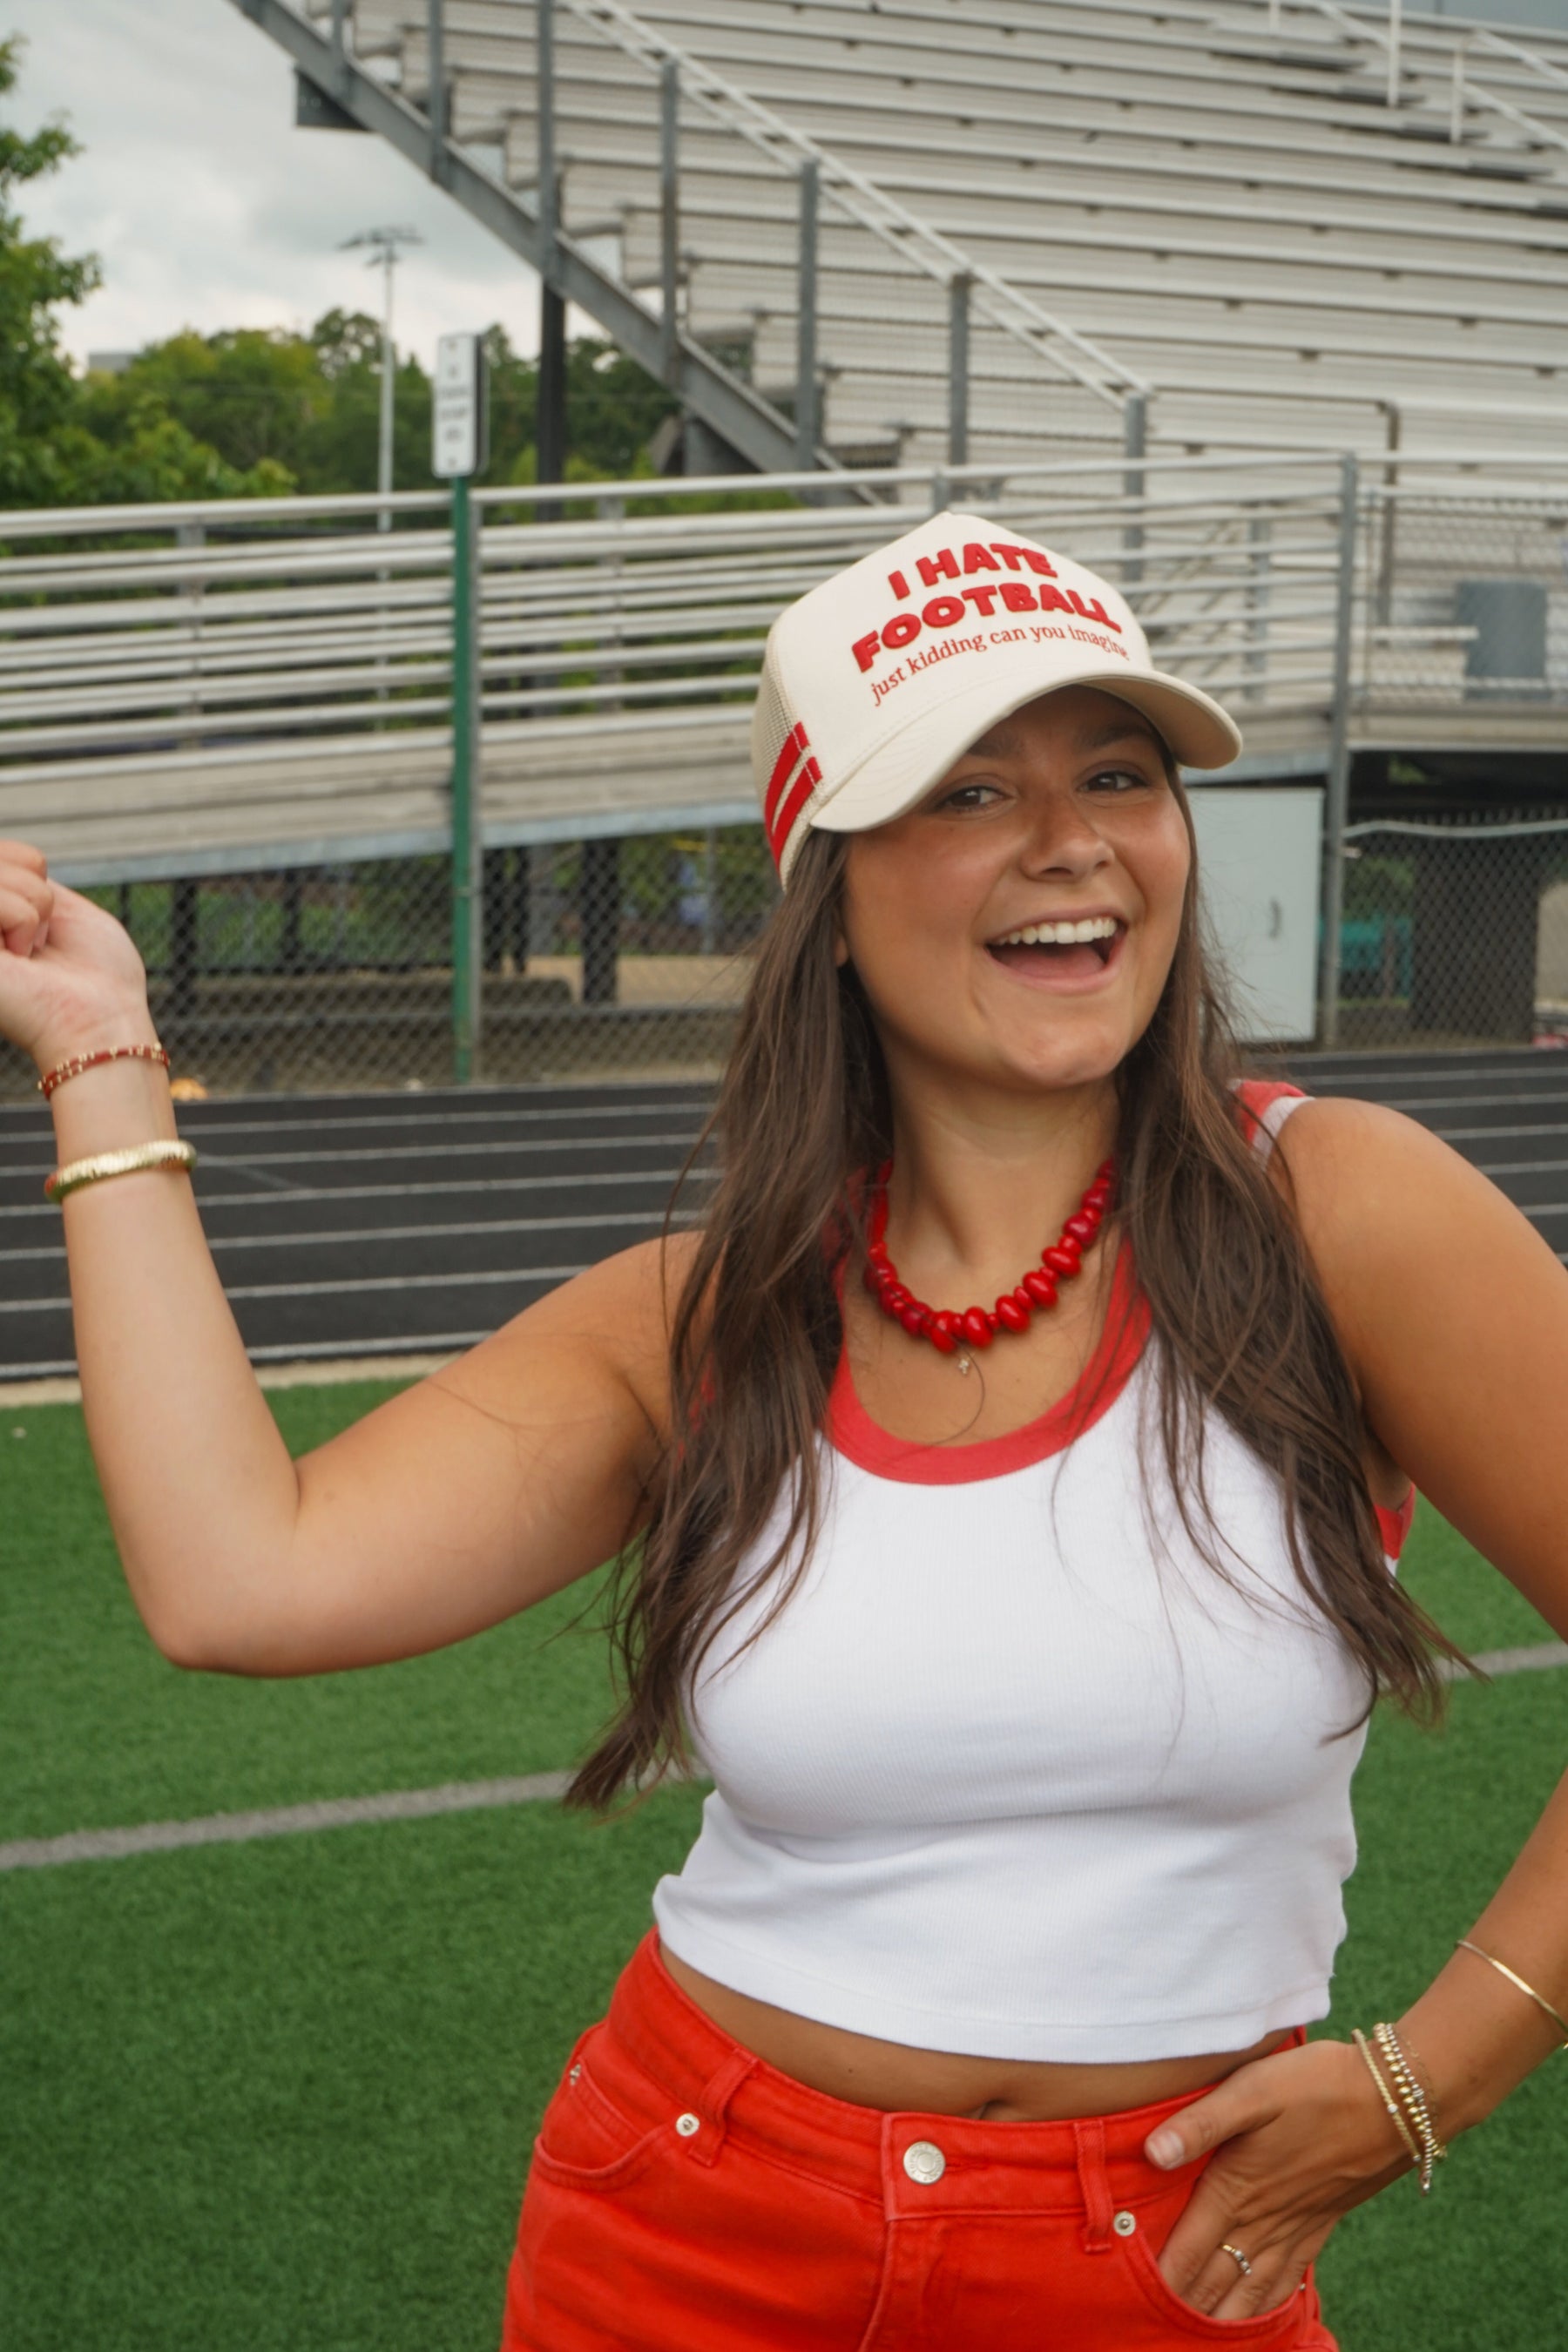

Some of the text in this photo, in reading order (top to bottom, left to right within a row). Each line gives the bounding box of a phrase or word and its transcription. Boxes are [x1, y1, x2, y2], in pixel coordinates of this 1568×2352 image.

[888, 543, 1058, 600] I HATE
[851, 582, 1123, 673] FOOTBALL
[870, 667, 906, 707] just
[906, 633, 987, 675] kidding
[990, 627, 1027, 645] can
[1030, 625, 1065, 643] you
